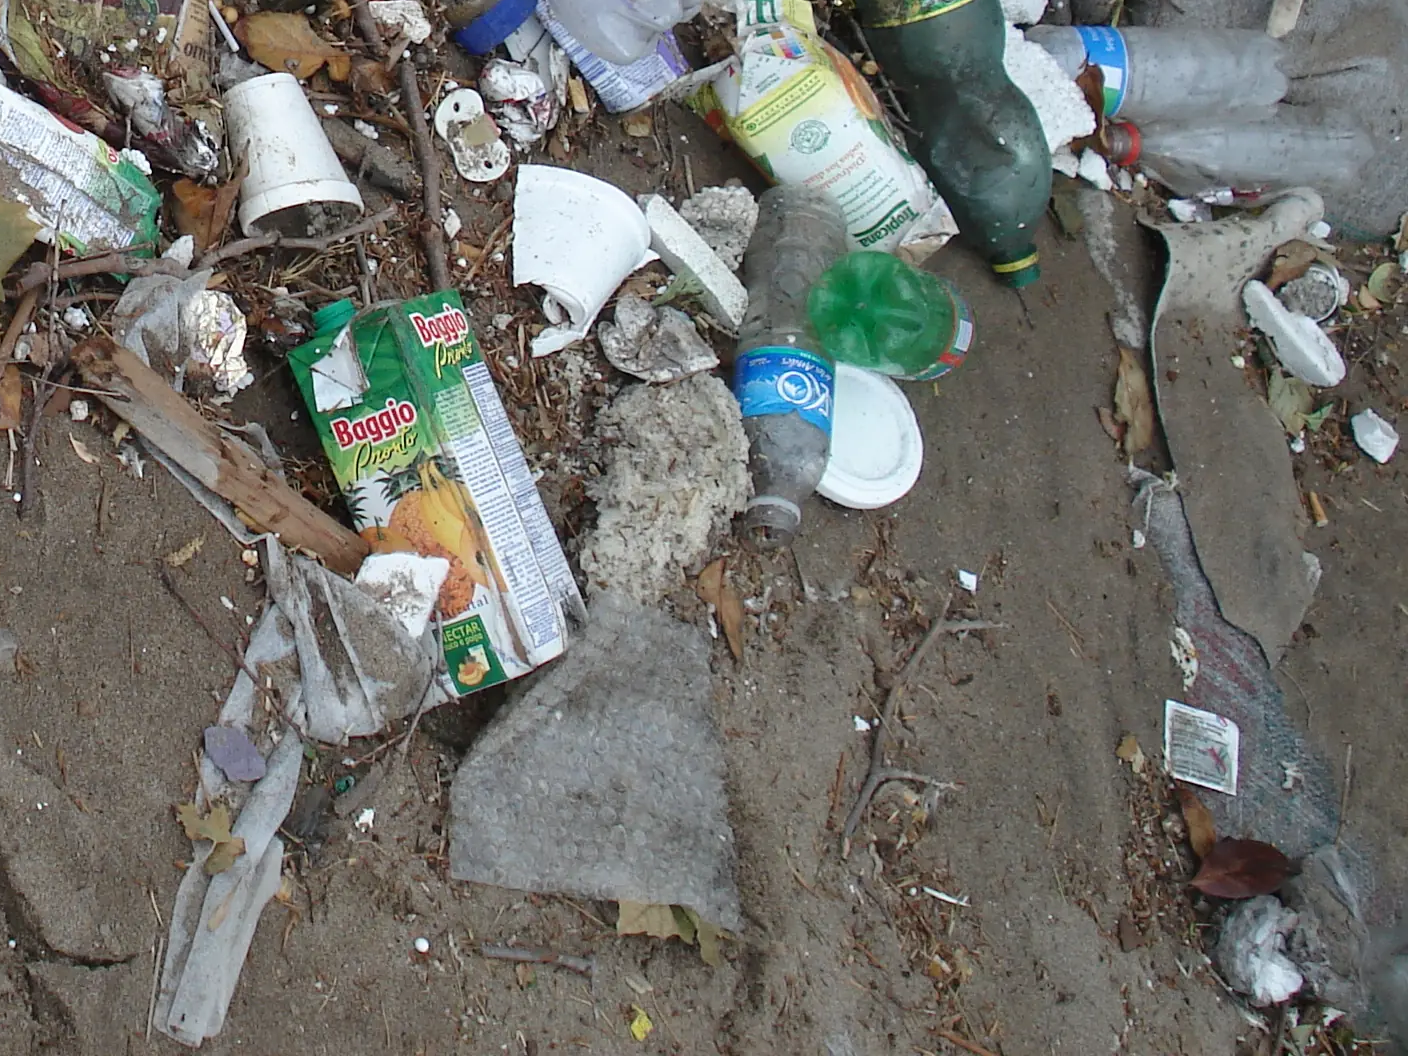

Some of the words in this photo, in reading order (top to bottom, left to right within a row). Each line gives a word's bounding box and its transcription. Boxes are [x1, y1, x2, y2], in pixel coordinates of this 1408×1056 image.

[858, 206, 920, 249] Tropicana
[410, 303, 469, 348] Baggio
[434, 333, 473, 379] Pronto
[331, 398, 419, 450] Baggio
[353, 427, 419, 476] Pronto
